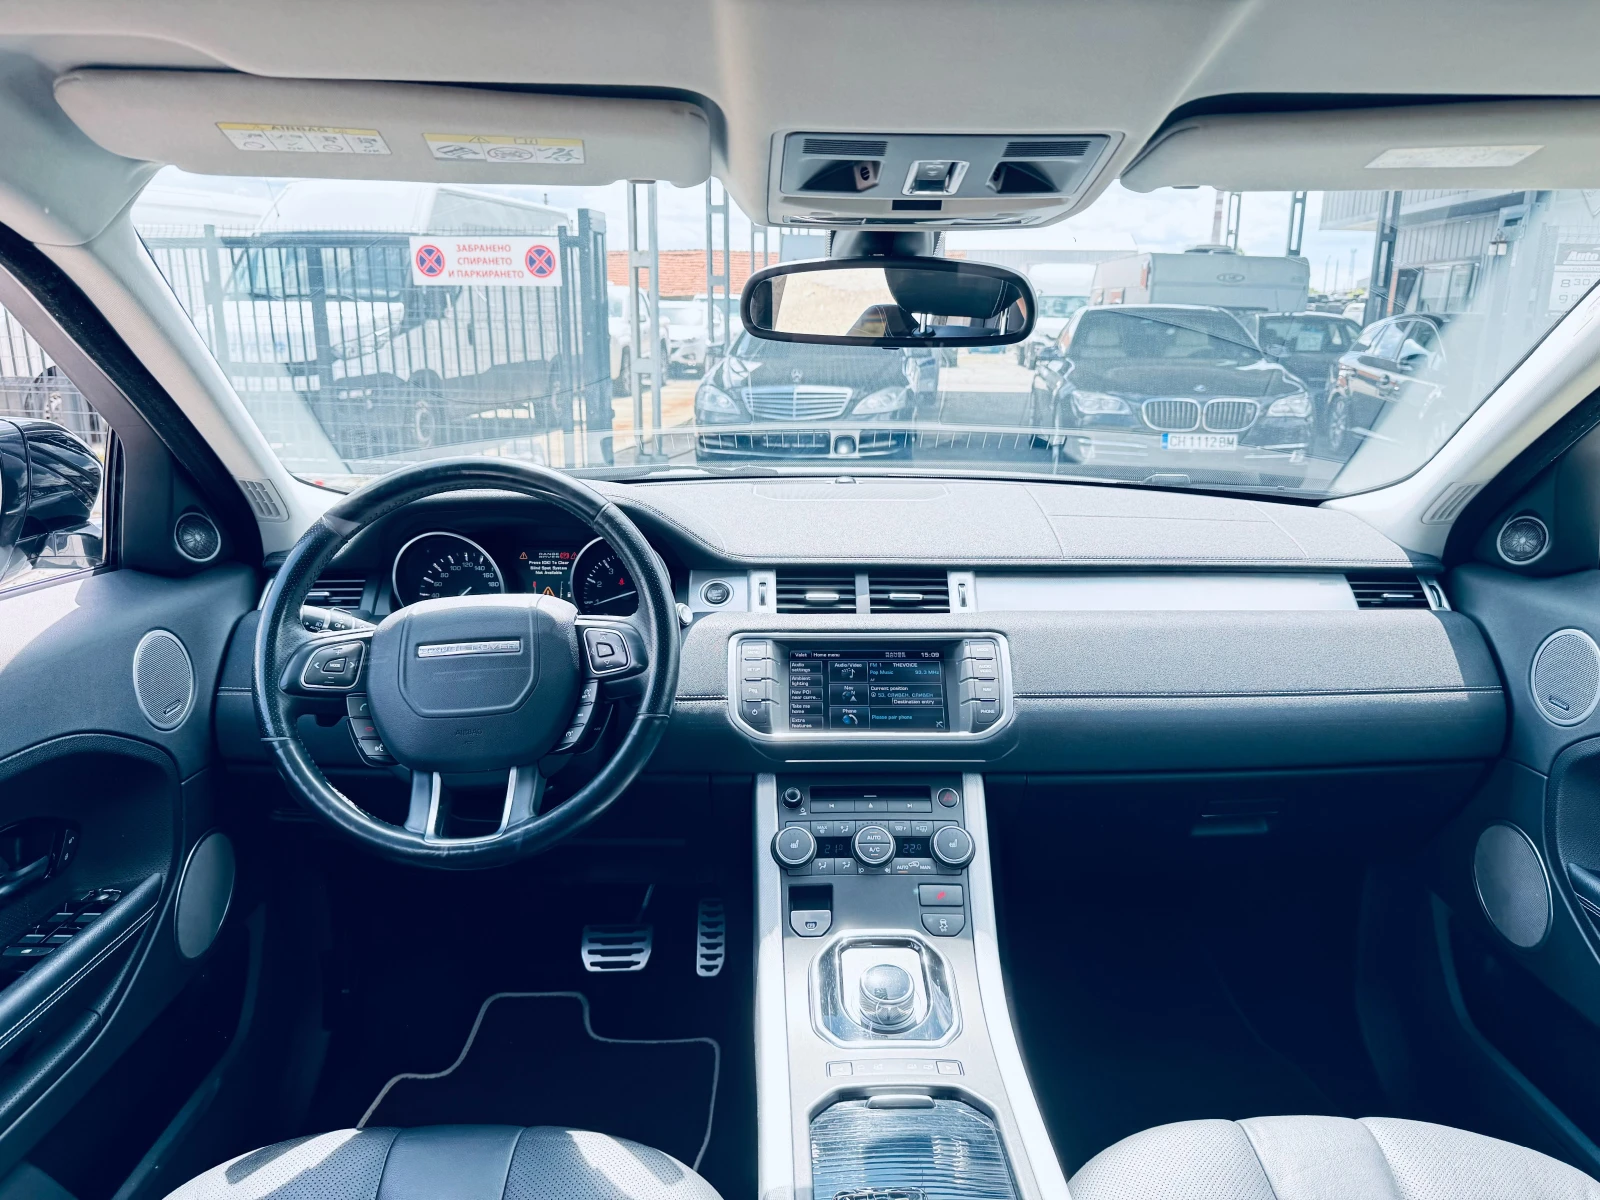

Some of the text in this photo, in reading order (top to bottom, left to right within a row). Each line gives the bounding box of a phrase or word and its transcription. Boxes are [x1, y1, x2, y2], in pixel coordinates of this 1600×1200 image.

[456, 244, 512, 253] ЗАБРАНЕНО
[457, 257, 512, 266] СПИРАНЕТО
[457, 270, 524, 278] ПАРКИРАНЕТО
